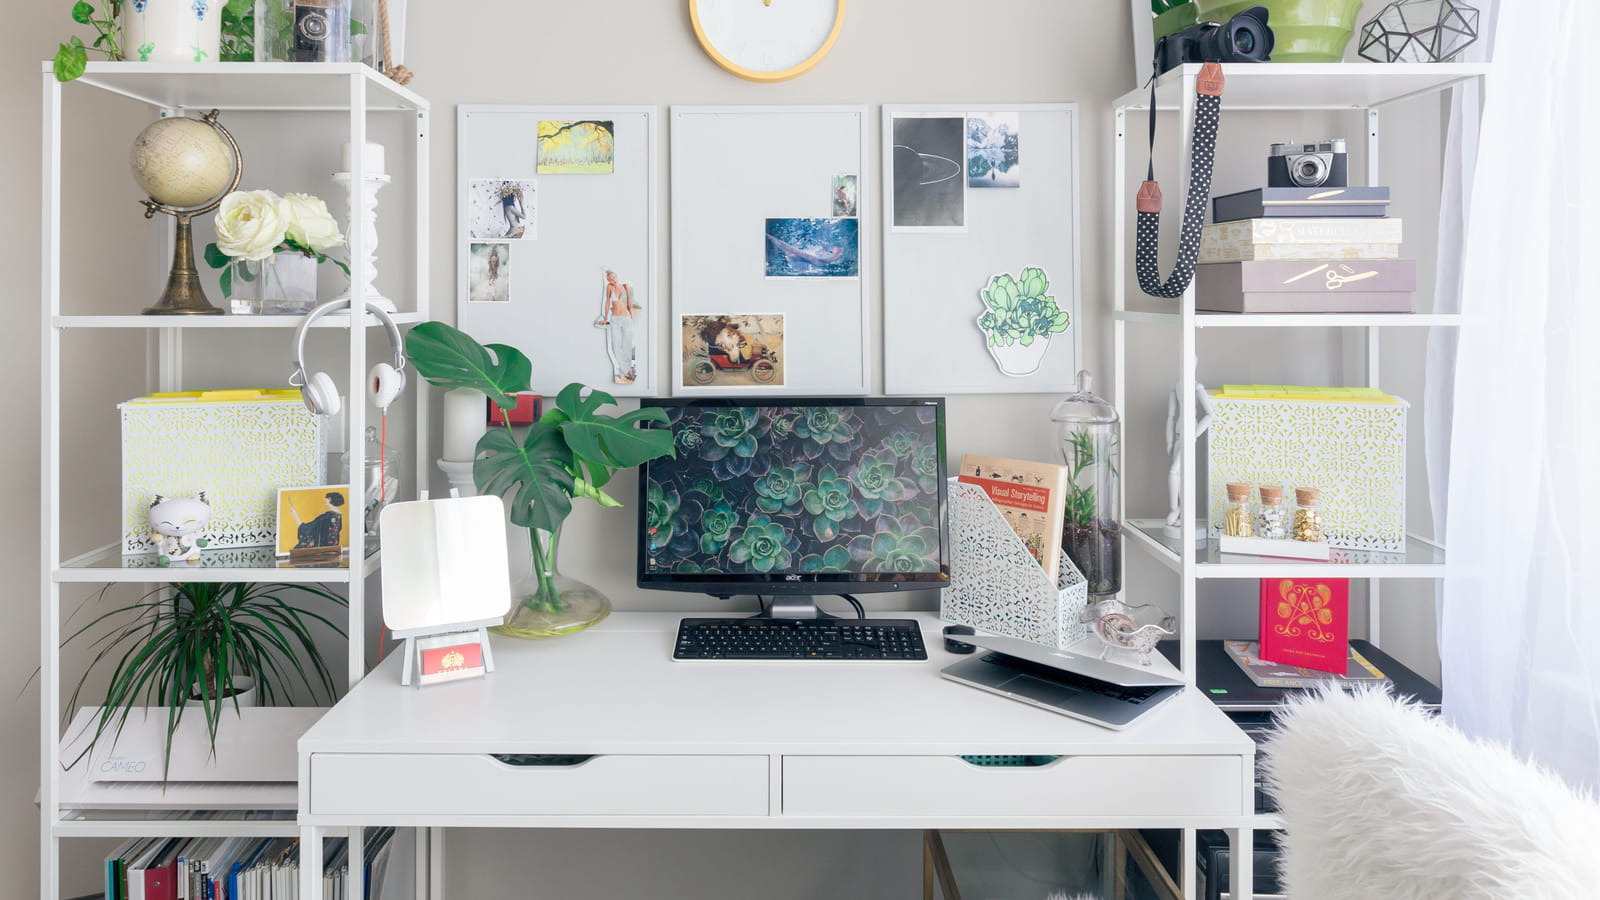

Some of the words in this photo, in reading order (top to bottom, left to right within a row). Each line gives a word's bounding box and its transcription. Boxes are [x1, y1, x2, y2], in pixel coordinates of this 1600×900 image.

[991, 484, 1010, 497] Visual
[1010, 488, 1046, 504] Storytelling
[100, 760, 147, 773] CAMEO
